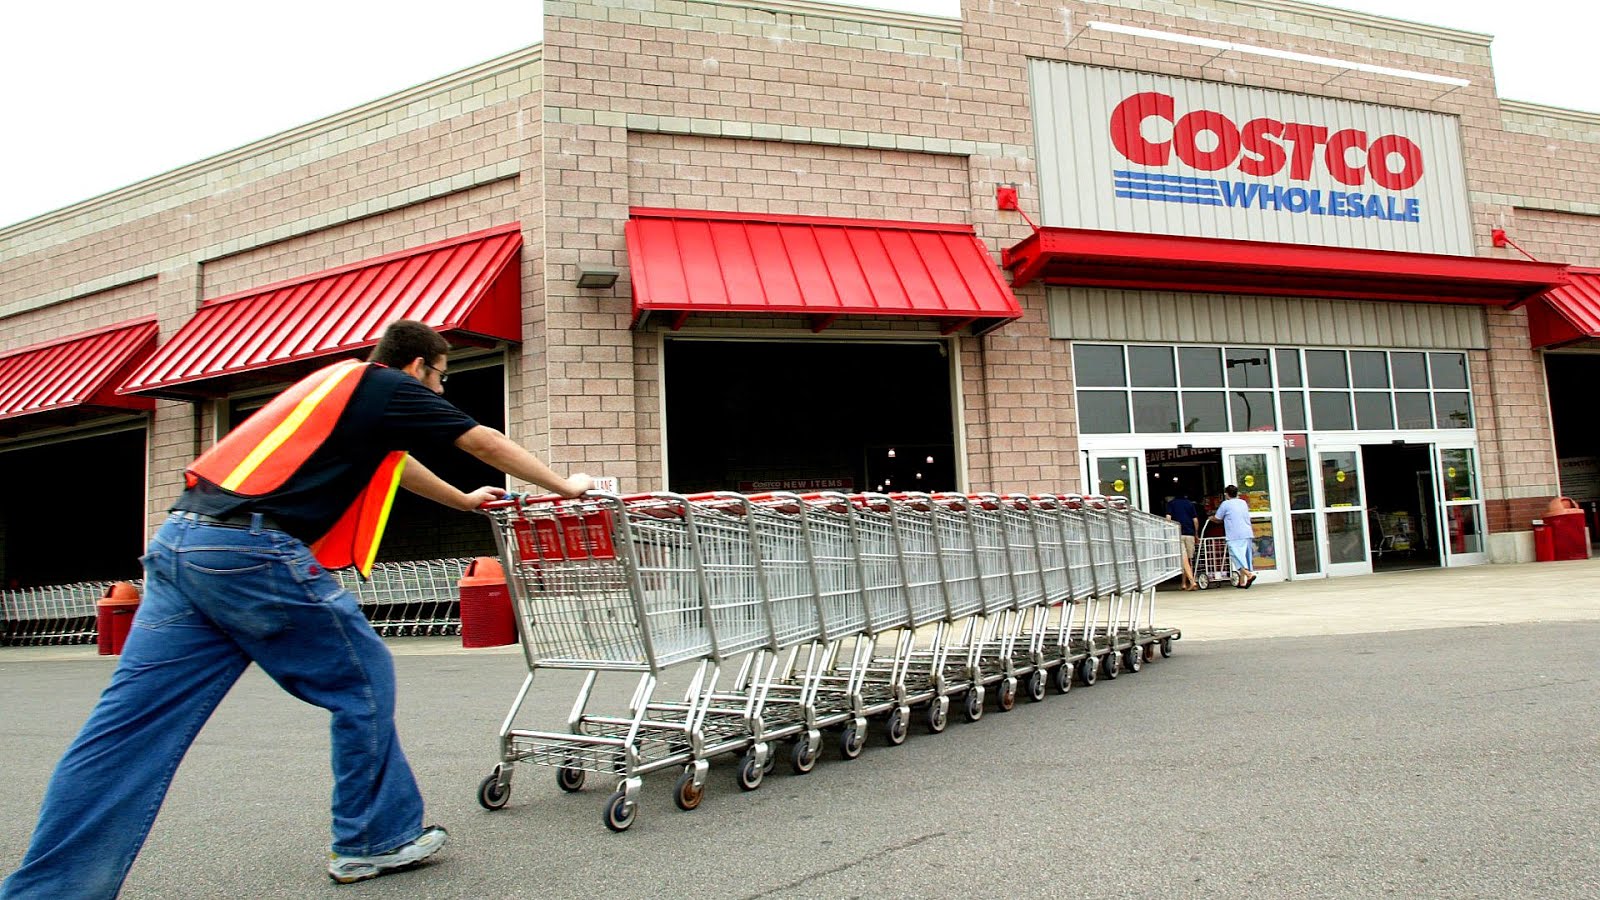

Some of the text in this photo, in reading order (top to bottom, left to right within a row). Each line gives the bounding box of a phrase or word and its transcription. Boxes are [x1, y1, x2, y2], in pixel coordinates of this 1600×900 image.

[1110, 91, 1424, 190] COSTCO
[1218, 180, 1420, 223] WHOLESALE
[1146, 451, 1166, 463] EAVE
[1167, 448, 1189, 460] FILM
[810, 479, 843, 487] ITEMS
